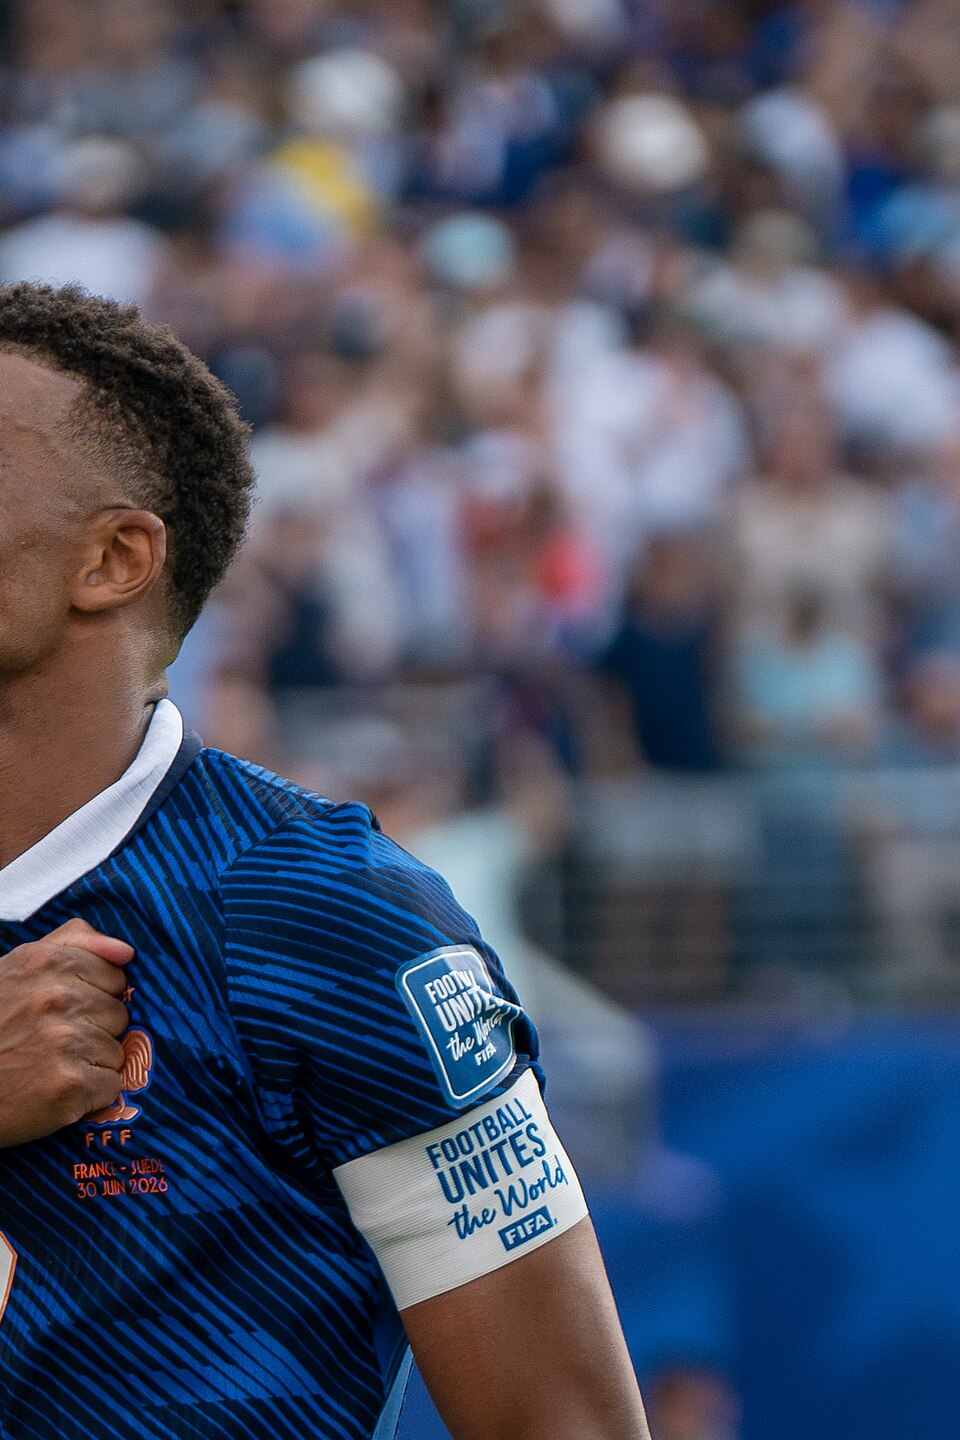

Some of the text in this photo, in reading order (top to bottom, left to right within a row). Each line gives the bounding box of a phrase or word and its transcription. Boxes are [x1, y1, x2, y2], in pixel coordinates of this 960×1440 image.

[446, 1031, 475, 1061] the
[425, 1098, 533, 1170] FOOTBALL
[73, 1161, 117, 1179] FRANCE
[437, 1122, 546, 1204] UNITES
[77, 1176, 169, 1199] 30 JUIN 2026
[447, 1154, 569, 1240] the World
[504, 1213, 549, 1246] FIFA
